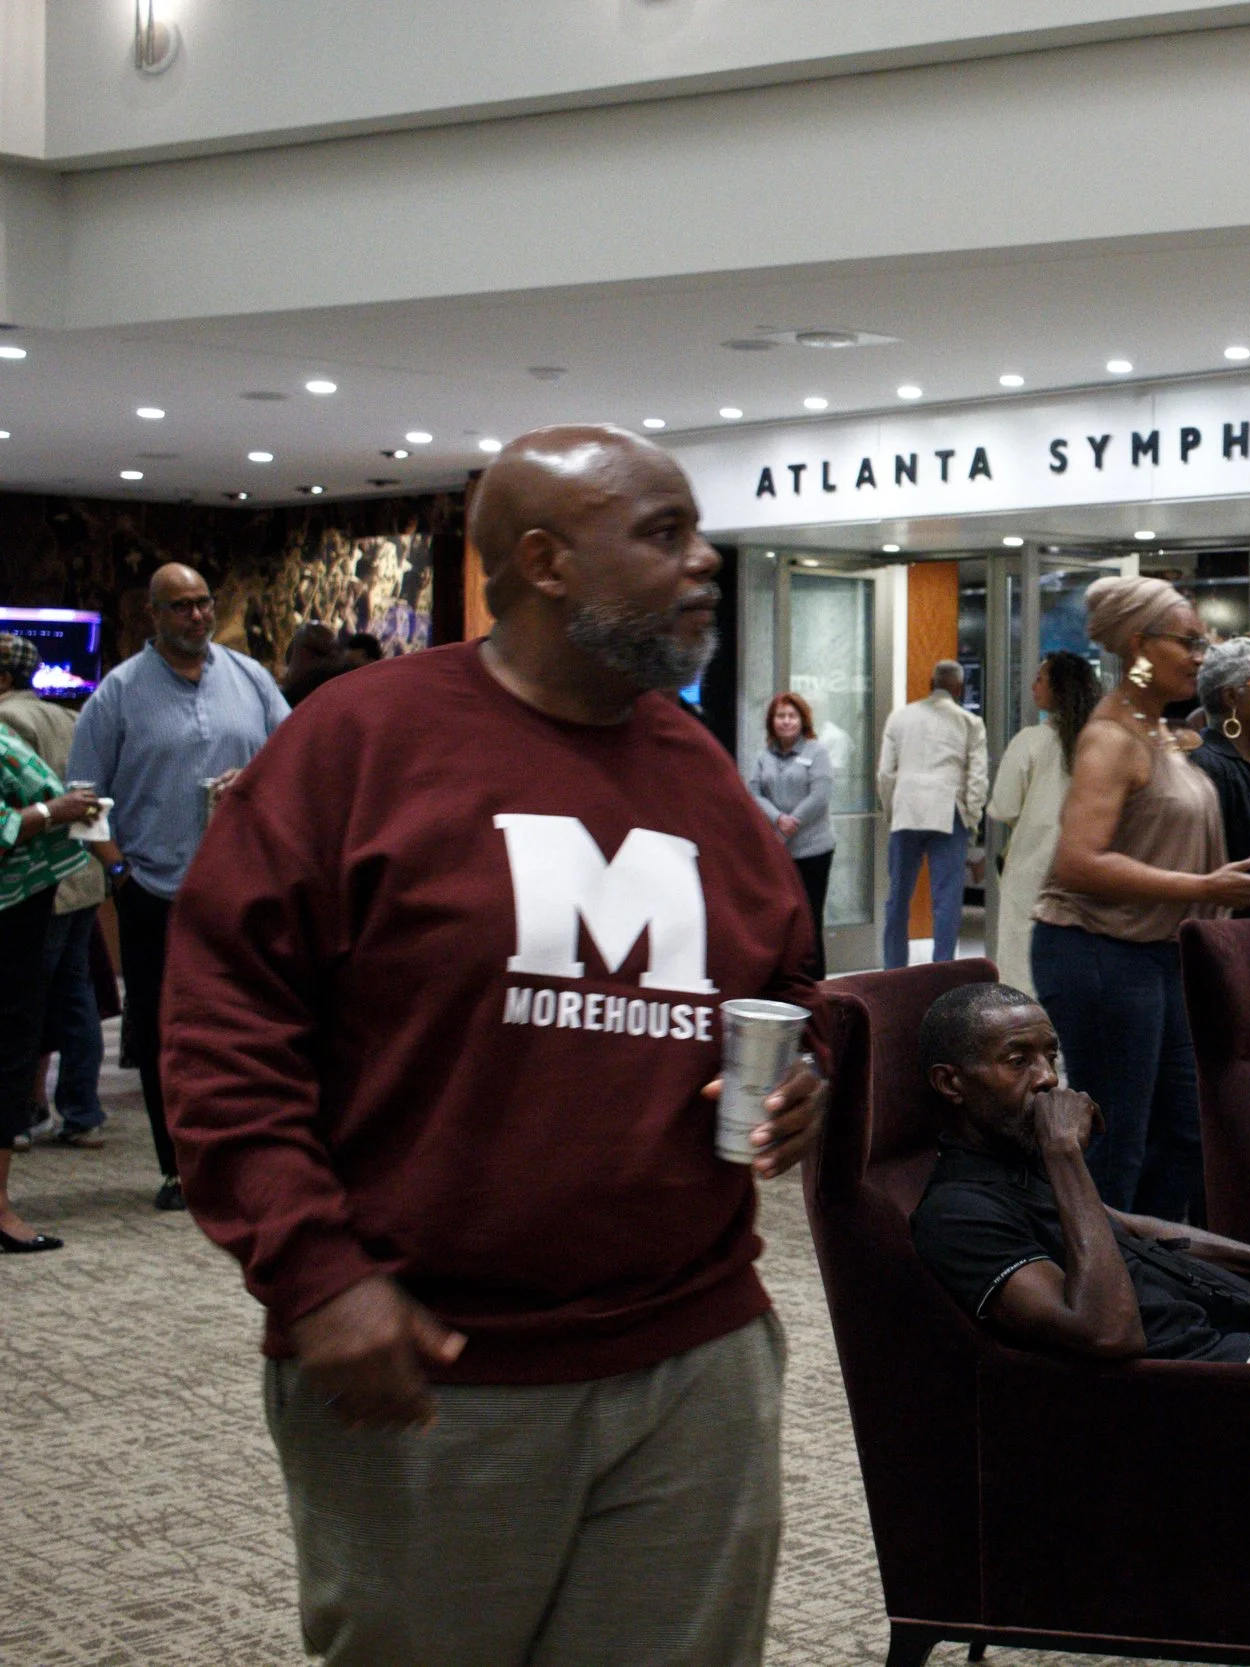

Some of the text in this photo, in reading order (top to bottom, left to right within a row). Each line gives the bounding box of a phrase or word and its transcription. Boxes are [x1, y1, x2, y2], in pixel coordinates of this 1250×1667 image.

[756, 446, 993, 498] ATLANTA
[492, 813, 720, 995] M
[503, 987, 713, 1042] MOREHOUSE
